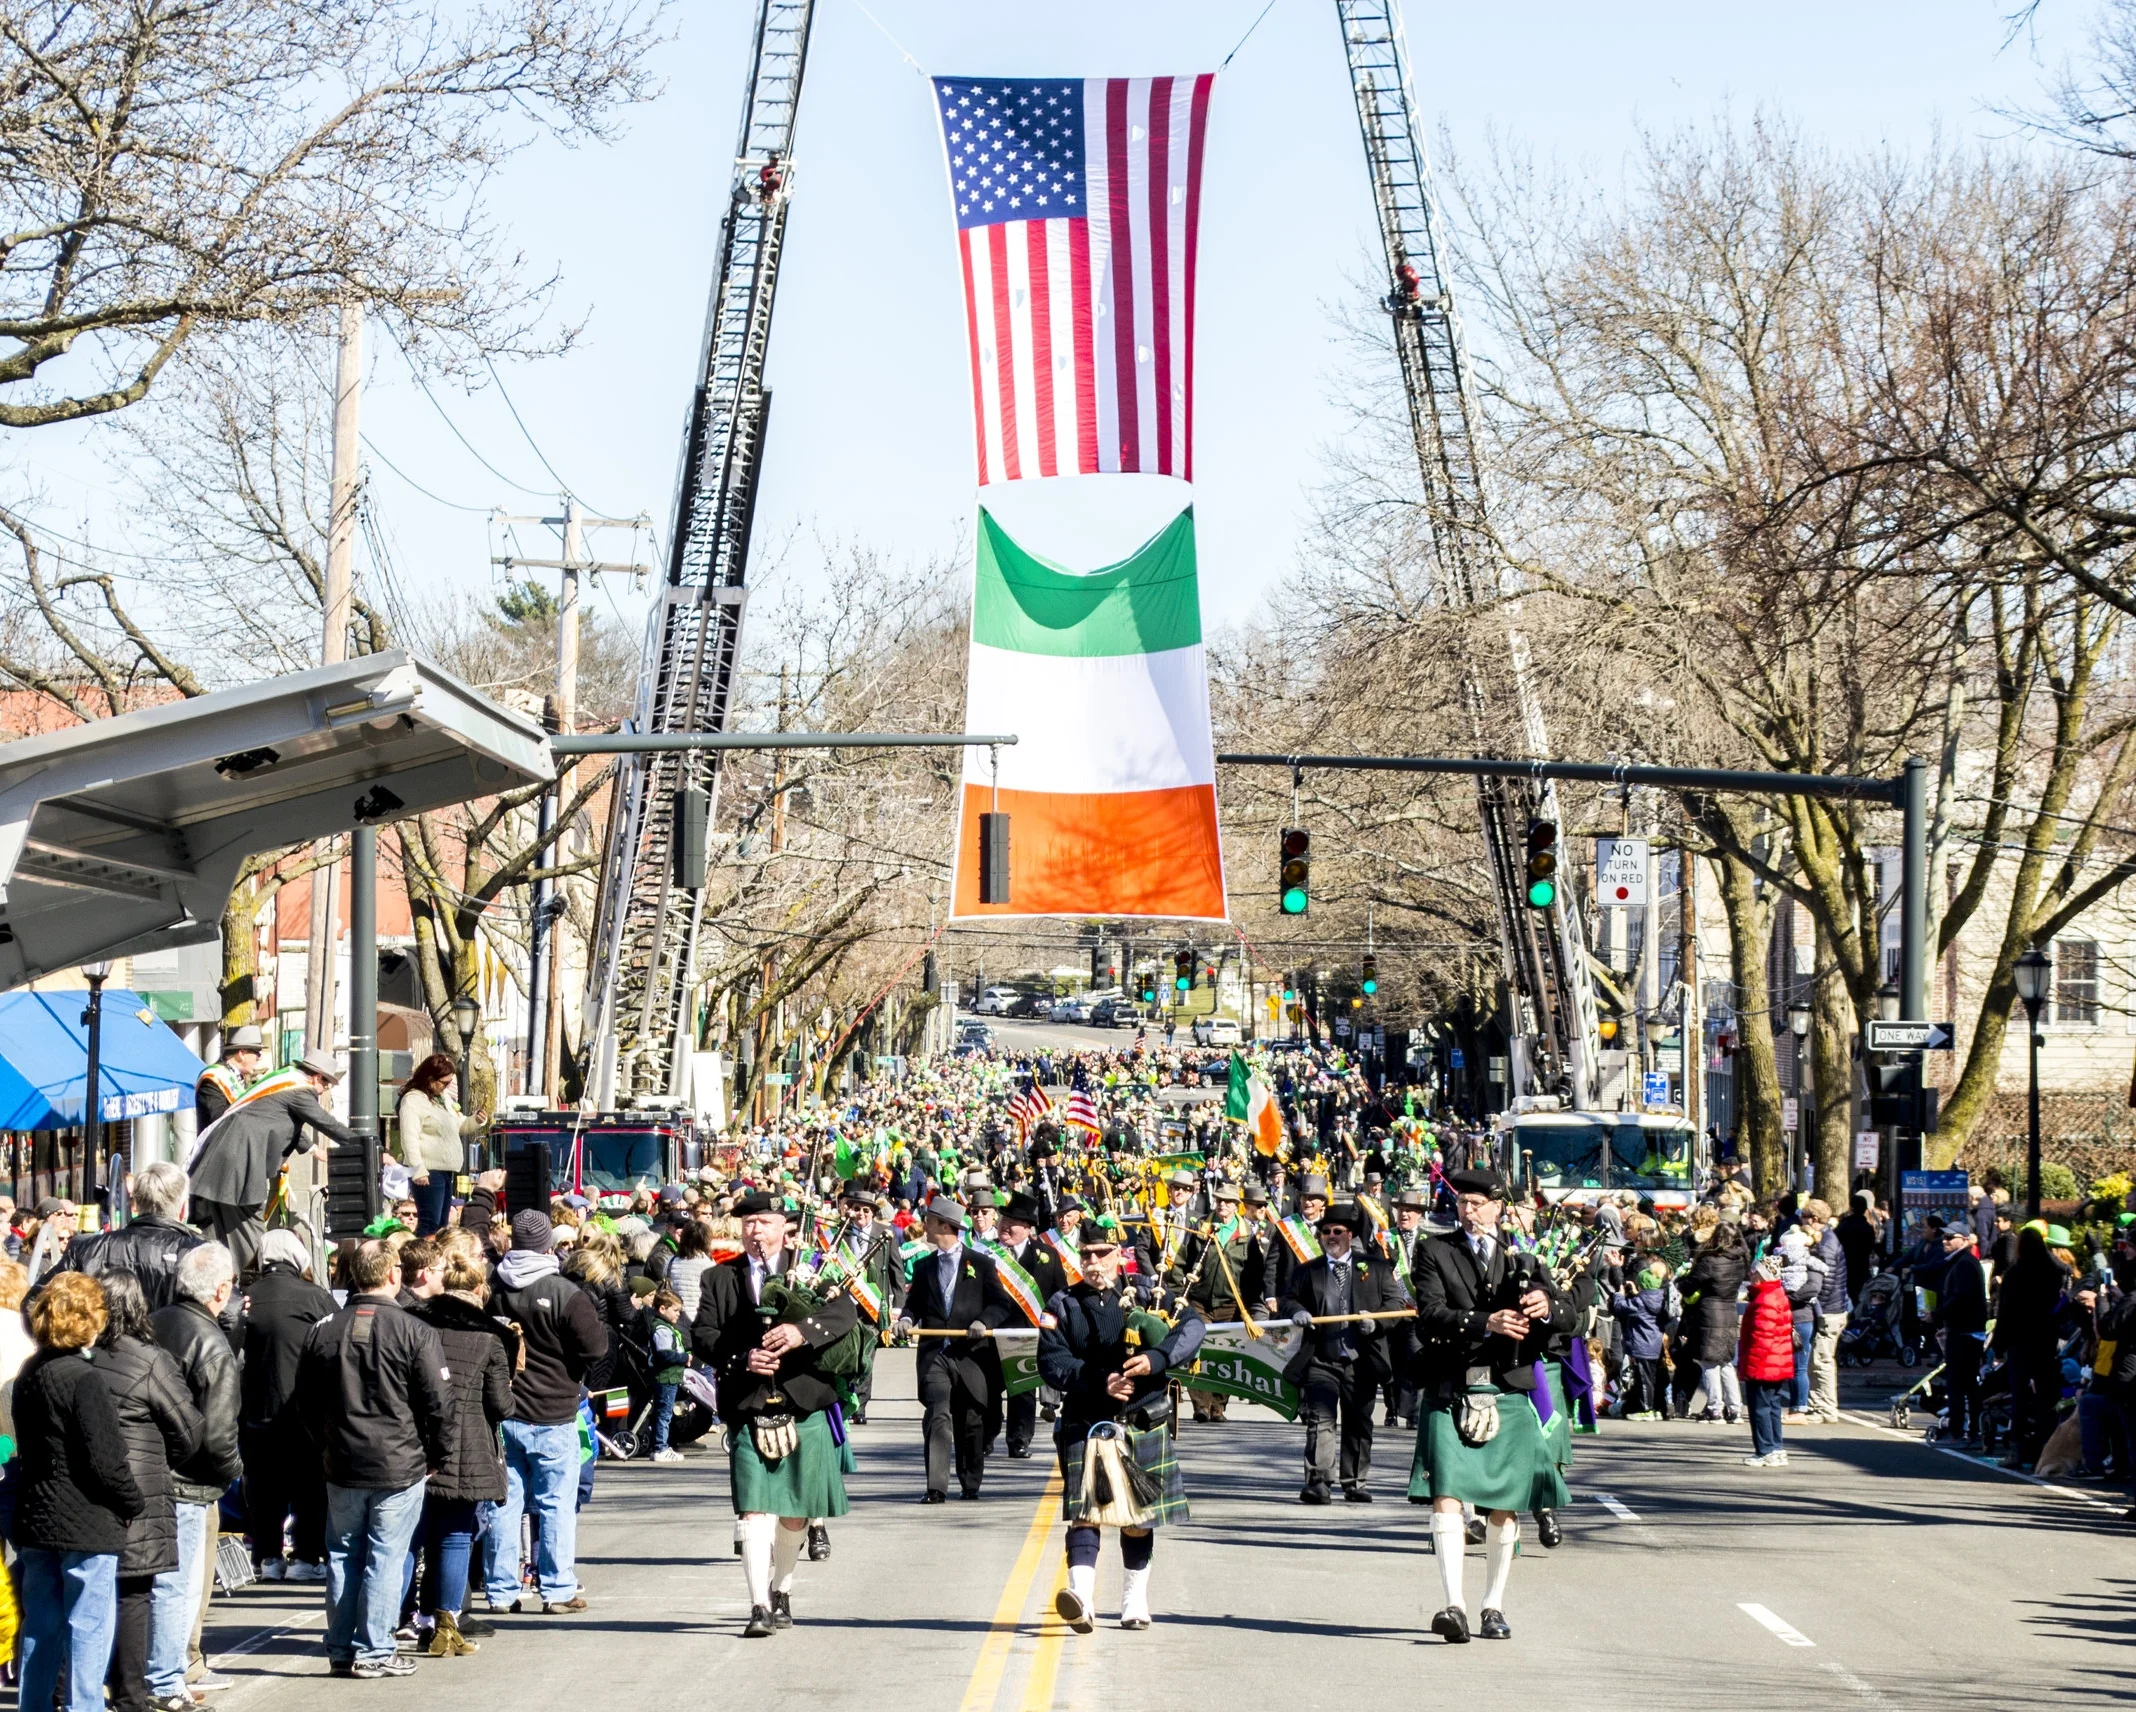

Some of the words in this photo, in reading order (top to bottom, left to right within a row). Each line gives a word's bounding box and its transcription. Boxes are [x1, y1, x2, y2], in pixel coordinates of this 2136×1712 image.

[1611, 844, 1633, 856] NO
[1607, 860, 1638, 870] TURN
[1601, 873, 1617, 883] ON
[1621, 873, 1643, 883] RED
[1879, 1030, 1902, 1041] ONE
[1906, 1030, 1929, 1041] WAY
[1655, 1074, 1666, 1087] P
[1202, 1337, 1246, 1349] N.Y.
[1179, 1360, 1285, 1399] rshal
